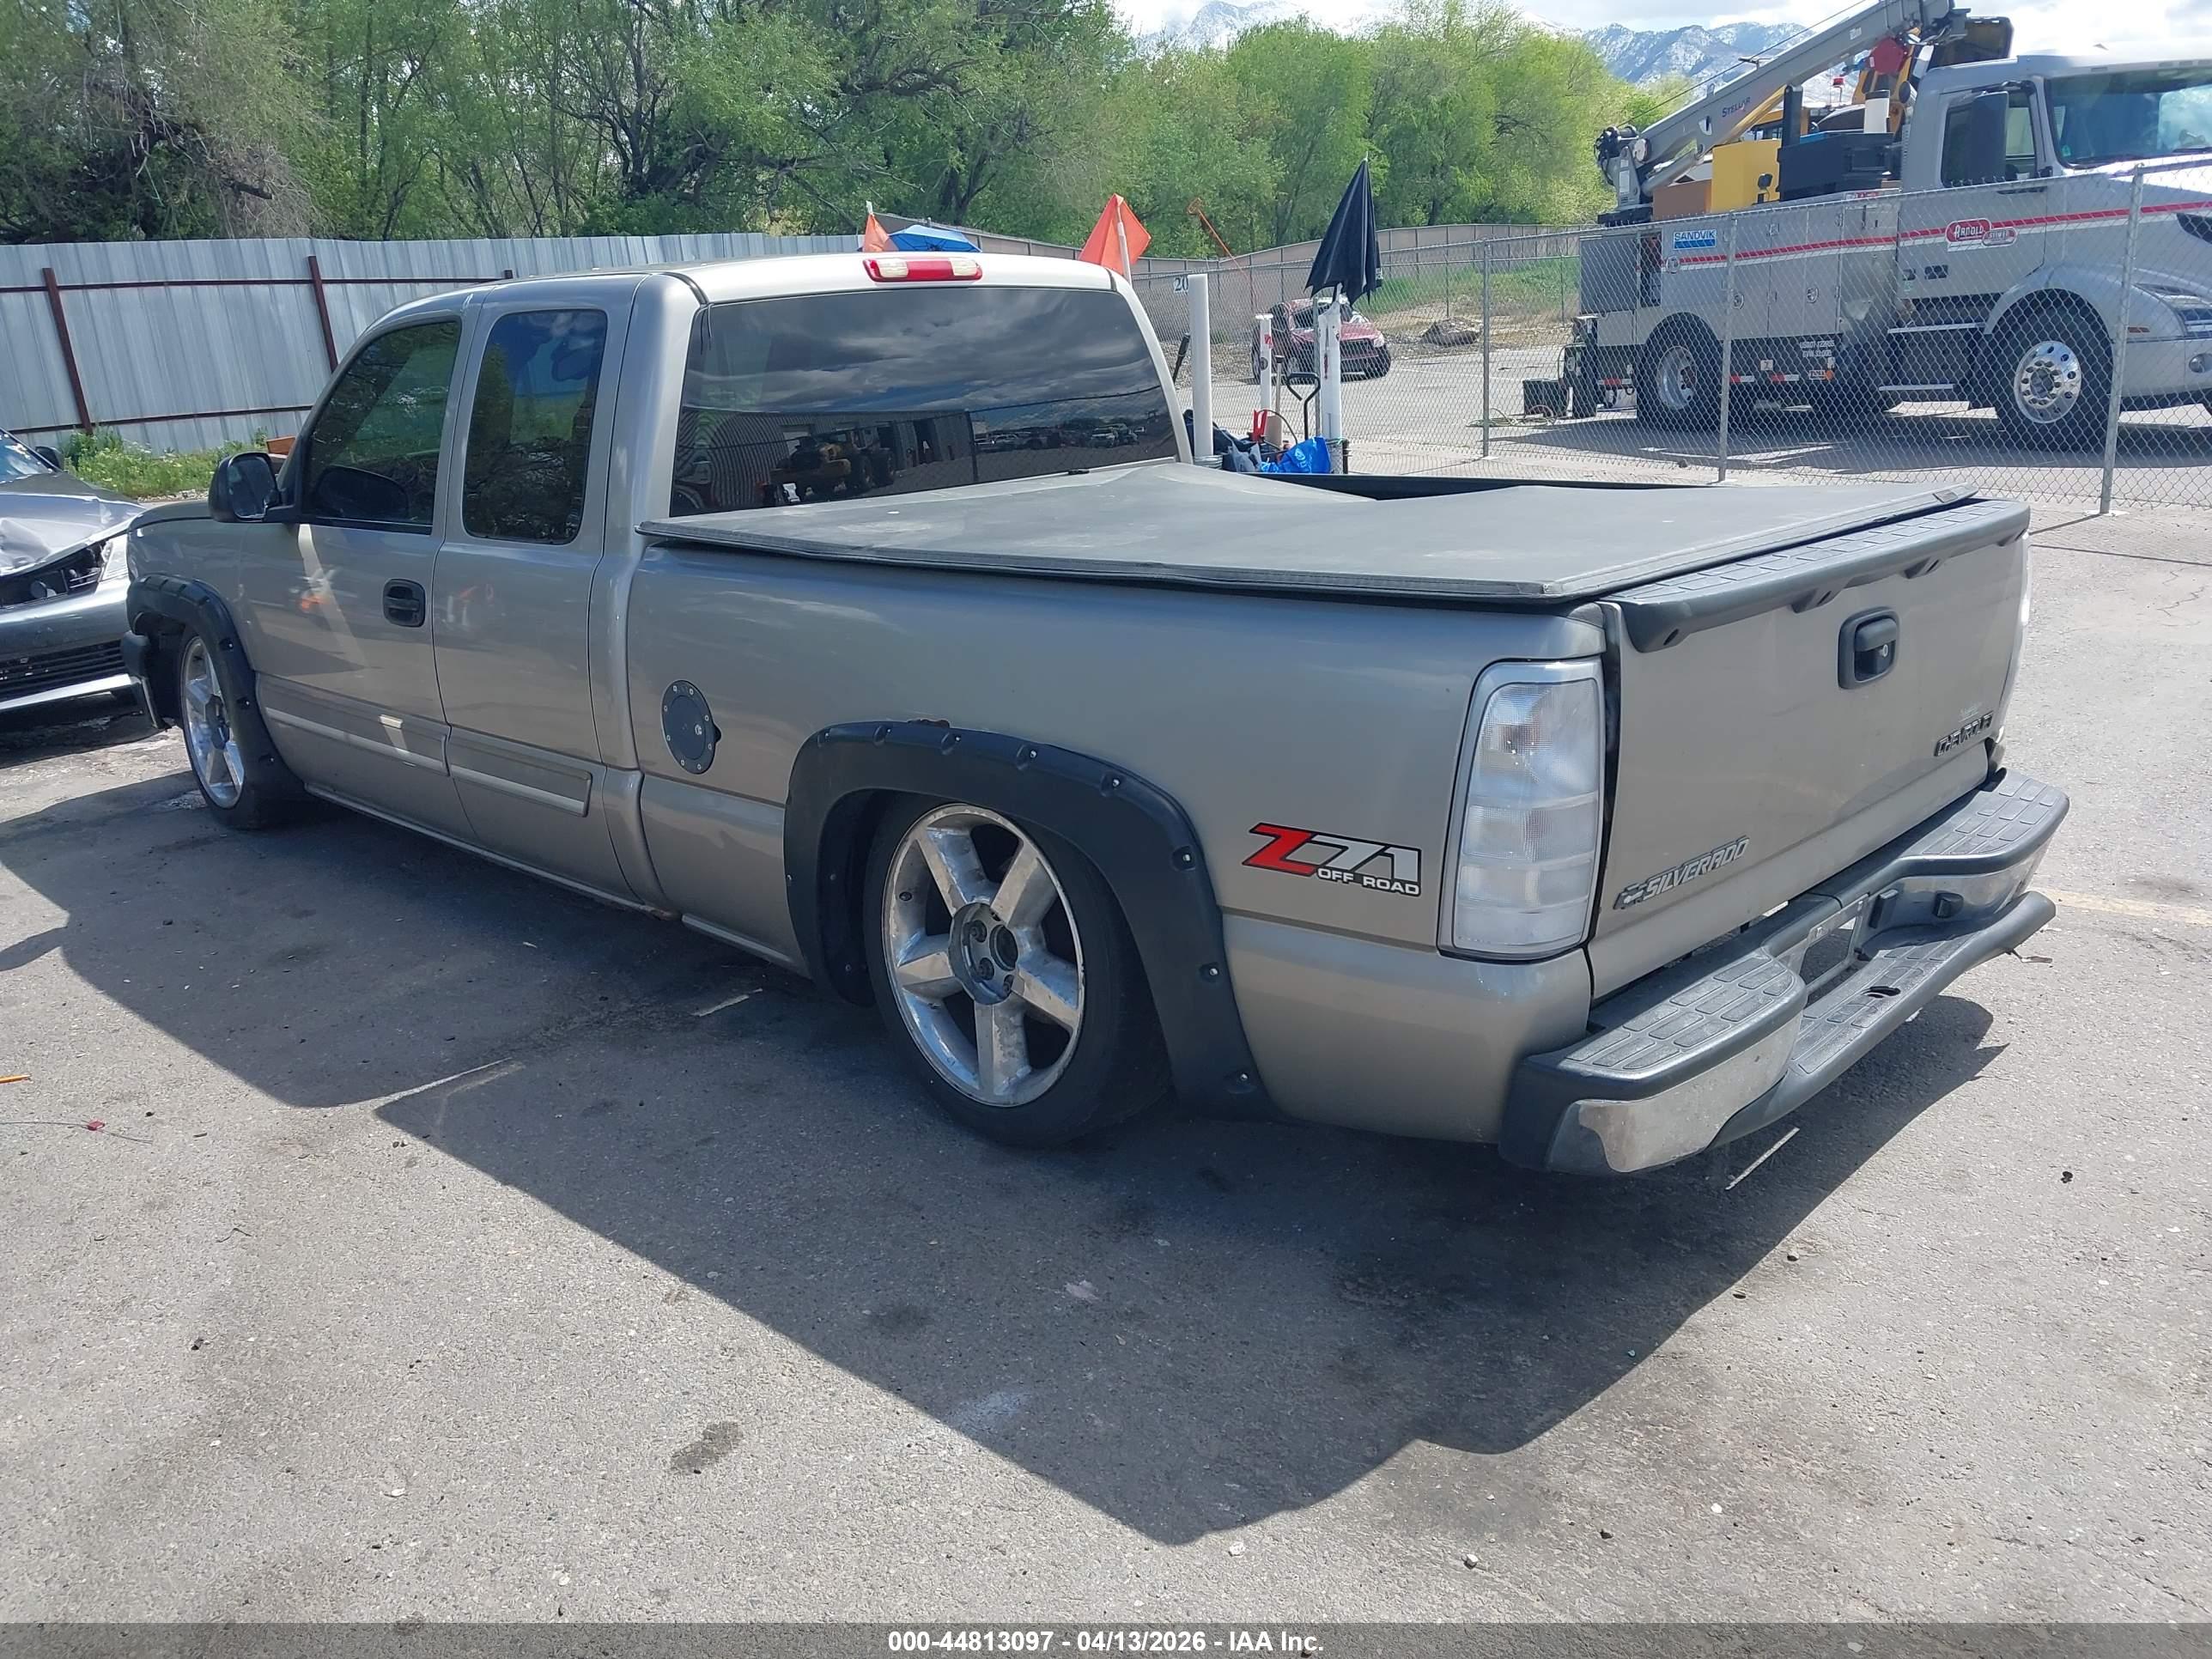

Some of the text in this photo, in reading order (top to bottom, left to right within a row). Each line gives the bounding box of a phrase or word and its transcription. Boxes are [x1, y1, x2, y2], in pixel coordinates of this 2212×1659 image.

[1674, 230, 1716, 241] SANDVIK
[1954, 224, 1984, 239] ARNOLD
[1242, 822, 1422, 884] Z71
[1316, 866, 1420, 897] OFF ROAD
[1642, 836, 1750, 902] SILVERADO
